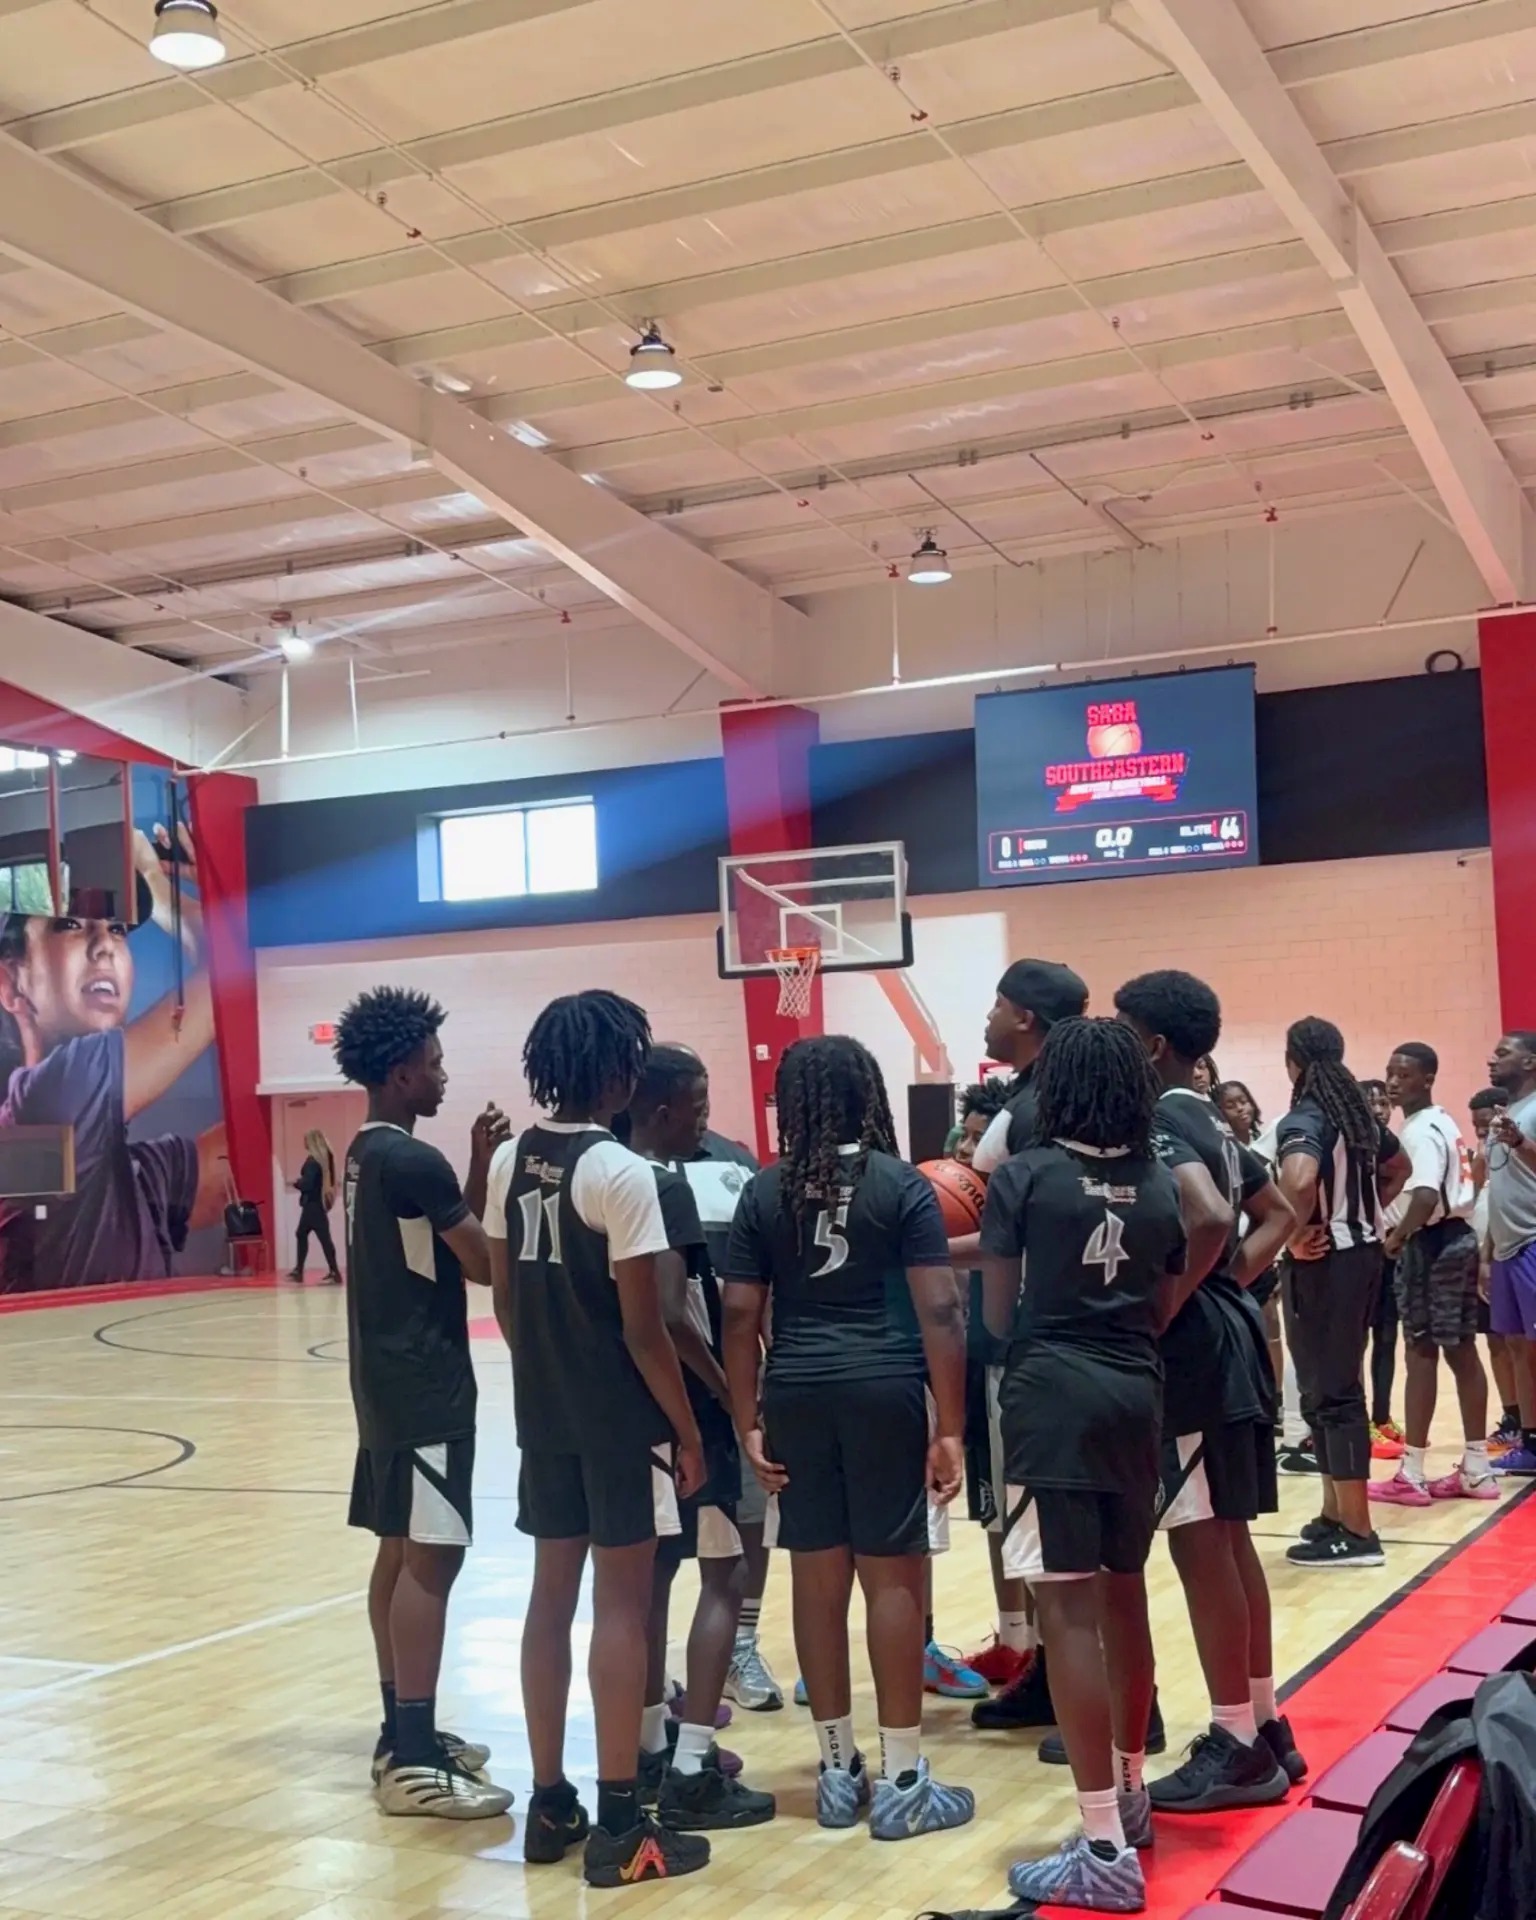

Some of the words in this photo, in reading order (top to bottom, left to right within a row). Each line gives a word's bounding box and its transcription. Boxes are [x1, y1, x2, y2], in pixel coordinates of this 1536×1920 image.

[1087, 701, 1137, 725] SABA
[1045, 753, 1185, 785] SOUTHEASTERN
[517, 1187, 563, 1264] 11
[809, 1204, 850, 1279] 5
[1082, 1207, 1131, 1287] 4
